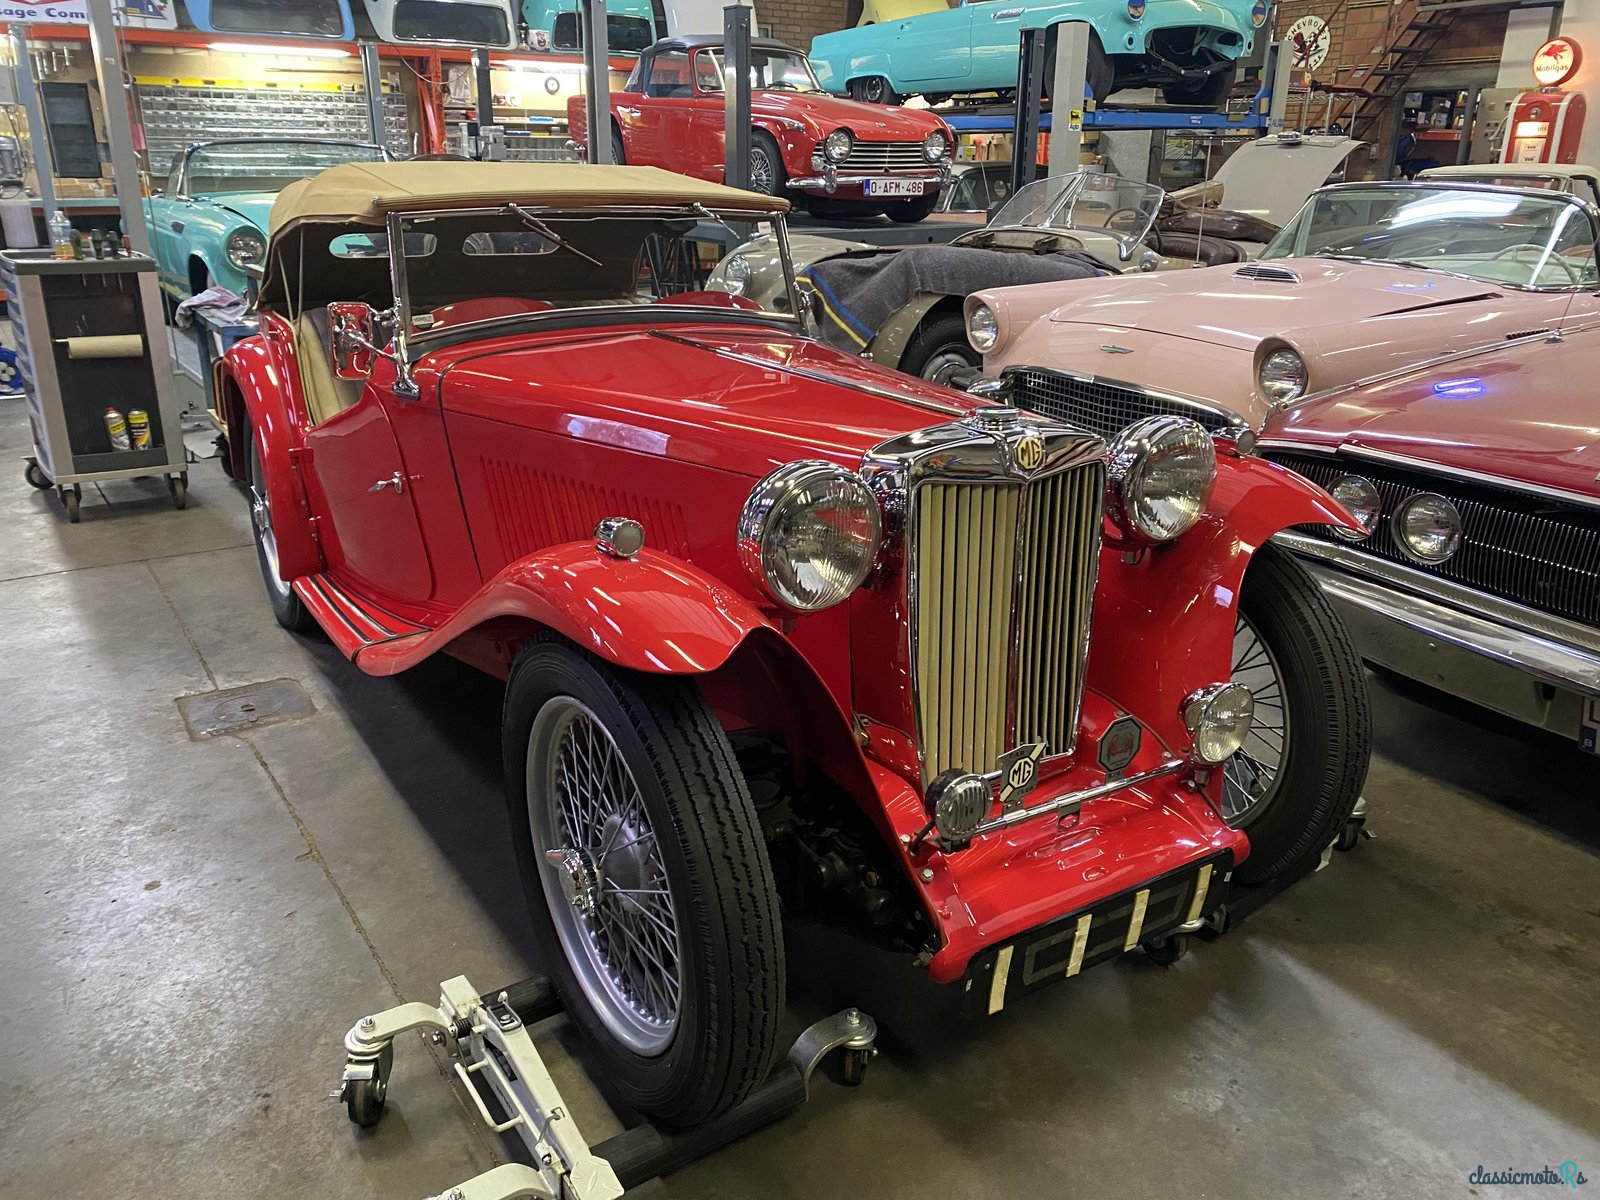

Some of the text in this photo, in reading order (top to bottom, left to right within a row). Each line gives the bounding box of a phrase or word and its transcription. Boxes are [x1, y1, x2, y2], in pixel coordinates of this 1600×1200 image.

[0, 8, 88, 19] age Com
[1536, 65, 1569, 73] Mobilgas
[1020, 439, 1041, 467] MG
[1011, 760, 1032, 785] MG
